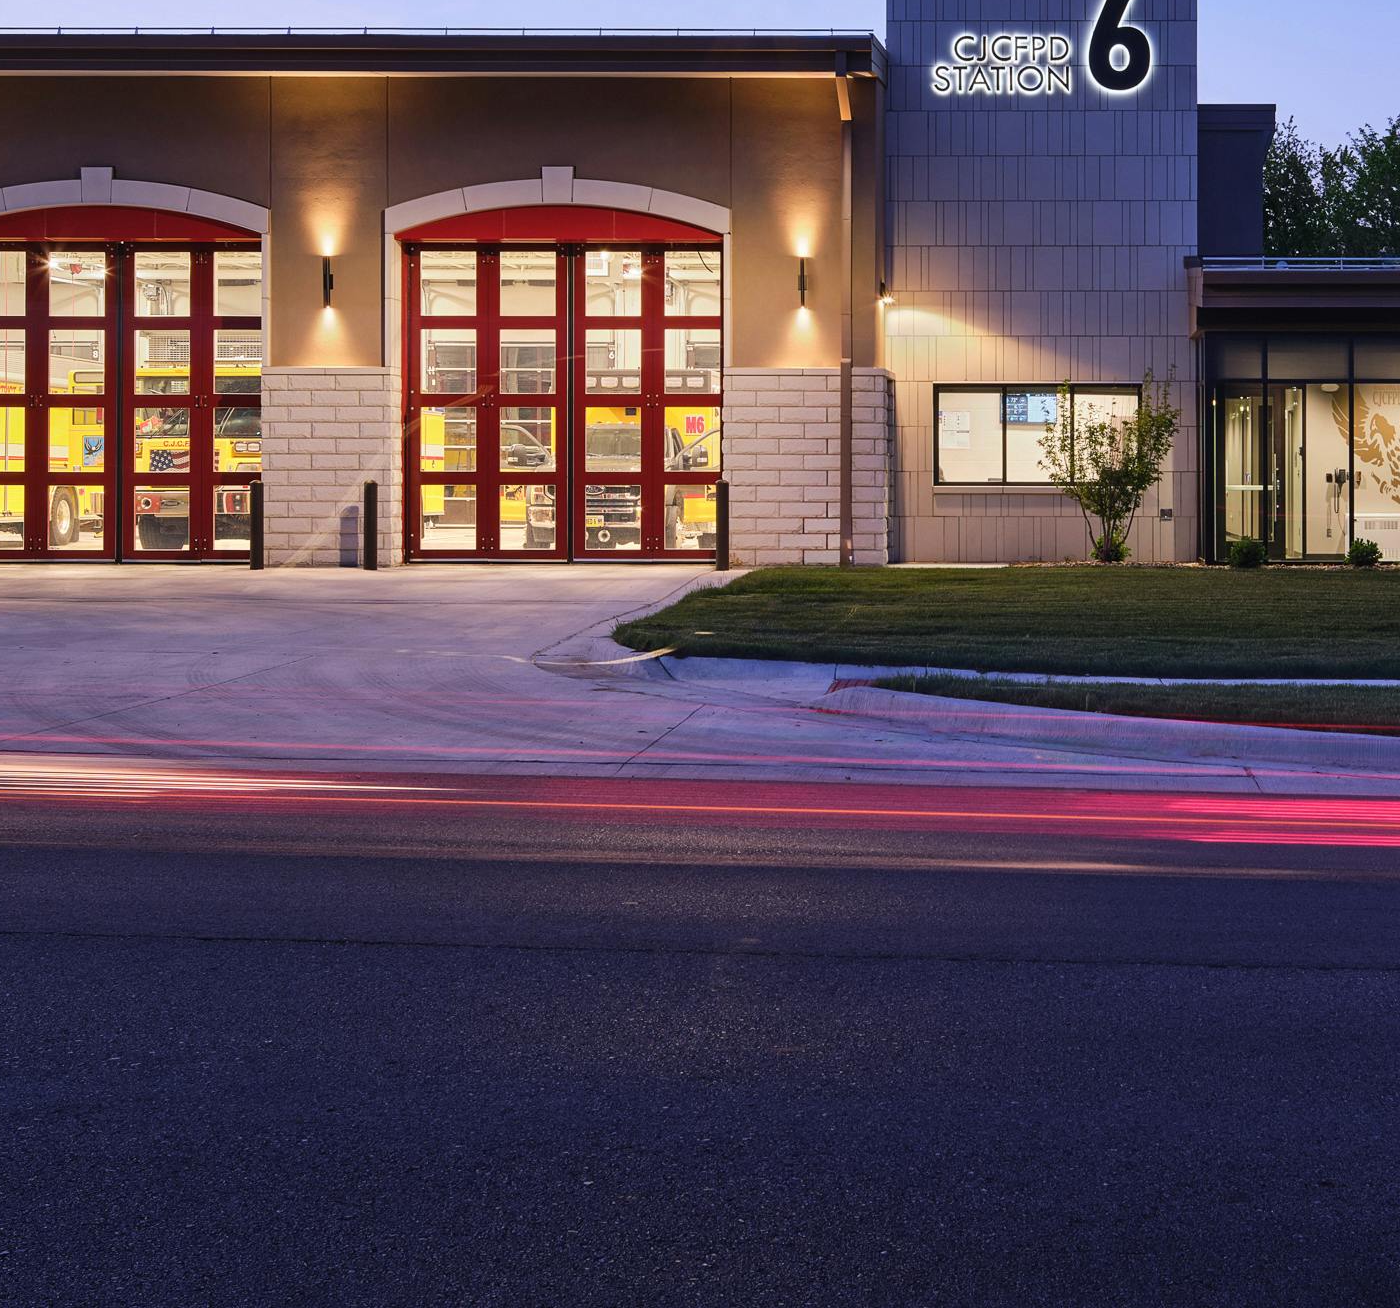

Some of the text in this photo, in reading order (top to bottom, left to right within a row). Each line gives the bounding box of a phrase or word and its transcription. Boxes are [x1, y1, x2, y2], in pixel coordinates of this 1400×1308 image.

[953, 35, 1070, 62] CJCFPD
[933, 65, 1071, 92] STATION
[685, 416, 705, 434] M6
